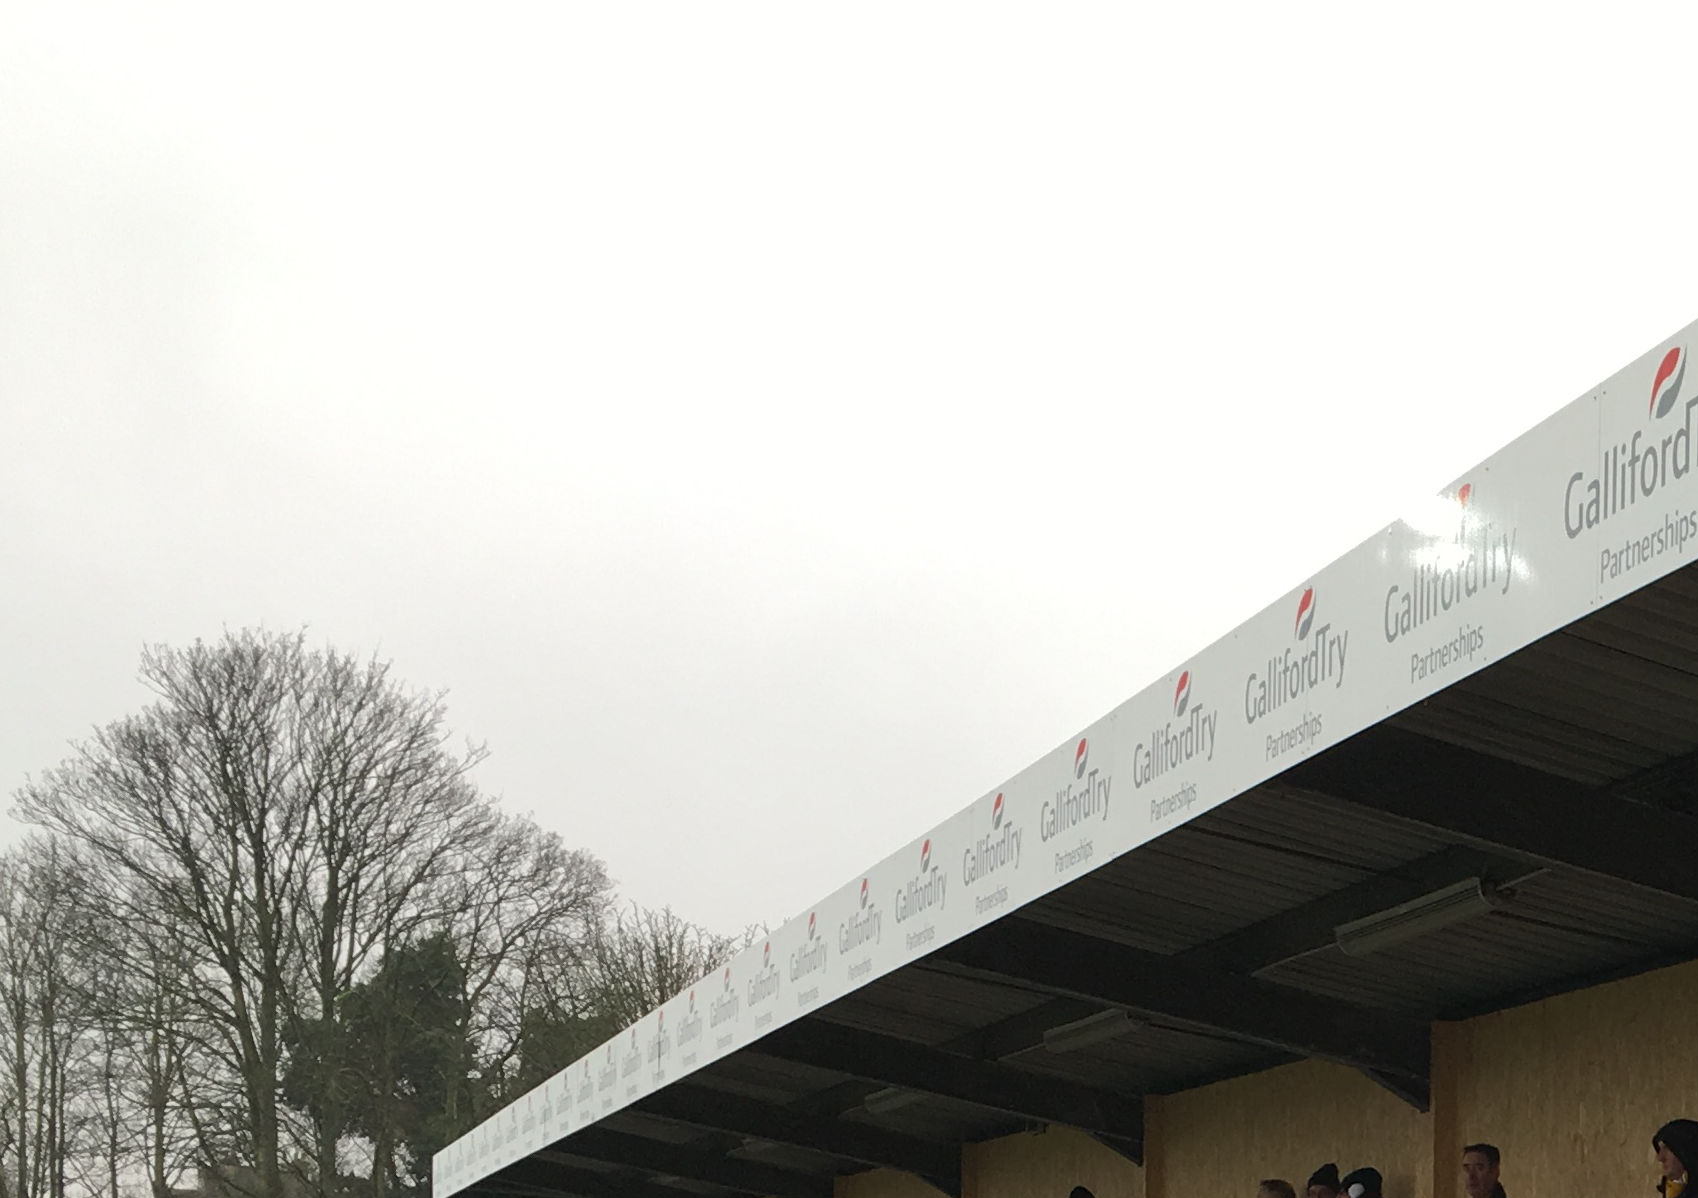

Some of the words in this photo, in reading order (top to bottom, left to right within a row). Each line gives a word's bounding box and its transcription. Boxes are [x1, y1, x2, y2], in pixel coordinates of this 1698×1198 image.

[1600, 507, 1698, 585] Partnerships
[1245, 623, 1349, 725] GallifordTry
[1411, 623, 1484, 685] Partnerships
[1133, 702, 1218, 789] GallifordTry
[1265, 711, 1323, 762] Partnerships
[1150, 780, 1197, 824] Partnerships
